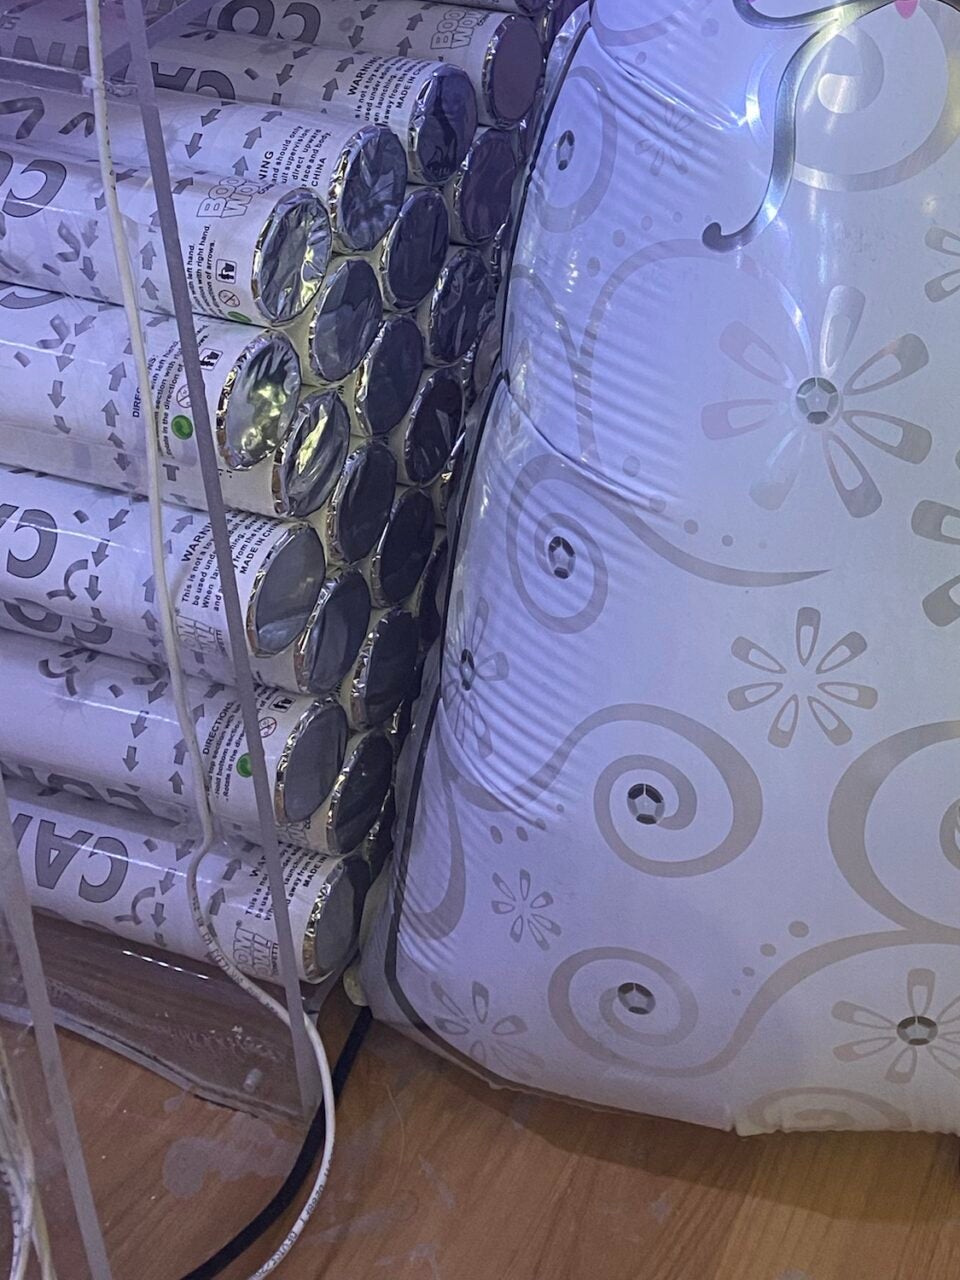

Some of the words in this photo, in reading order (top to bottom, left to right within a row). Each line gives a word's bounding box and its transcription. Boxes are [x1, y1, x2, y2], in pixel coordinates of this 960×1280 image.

[395, 85, 411, 109] MADE
[275, 139, 292, 166] should
[291, 156, 305, 181] direct
[302, 129, 322, 153] upward
[301, 164, 312, 182] face
[308, 148, 319, 164] and
[311, 157, 327, 187] CHINA
[196, 247, 205, 267] right
[155, 379, 167, 410] section
[164, 361, 176, 377] with
[163, 374, 180, 410] direction
[233, 543, 248, 562] from
[239, 547, 258, 574] MADE
[181, 584, 192, 602] This
[192, 557, 203, 572] not
[196, 571, 208, 594] used
[201, 584, 214, 609] When
[216, 748, 229, 776] bottom
[288, 877, 302, 898] away
[297, 861, 311, 876] from
[302, 863, 321, 887] MADE
[245, 897, 258, 915] This
